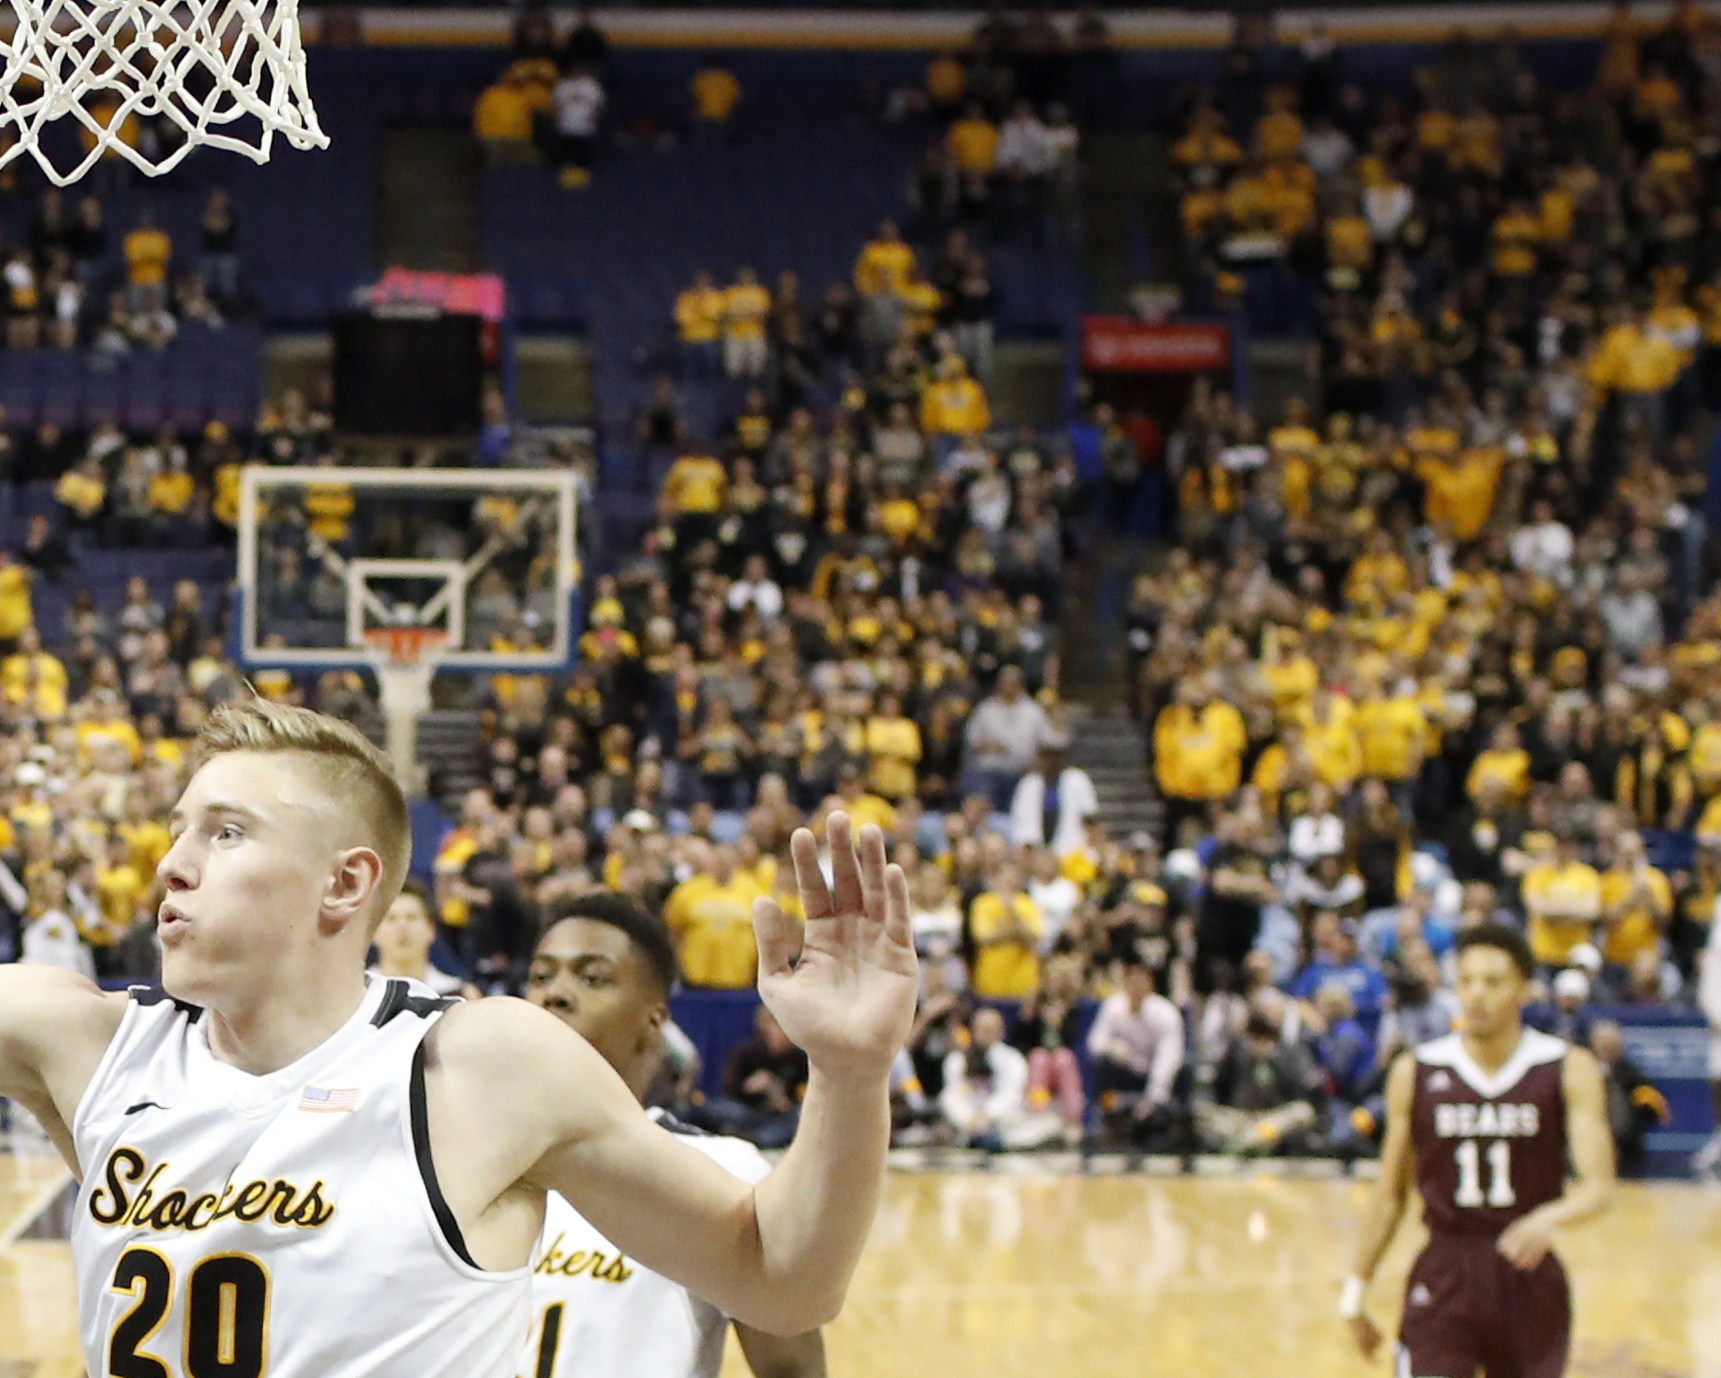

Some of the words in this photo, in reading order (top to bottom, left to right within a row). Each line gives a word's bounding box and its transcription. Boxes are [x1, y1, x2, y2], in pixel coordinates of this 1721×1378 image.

[1434, 1102, 1540, 1139] BEARS
[1452, 1139, 1517, 1208] 11
[534, 1231, 633, 1284] kers
